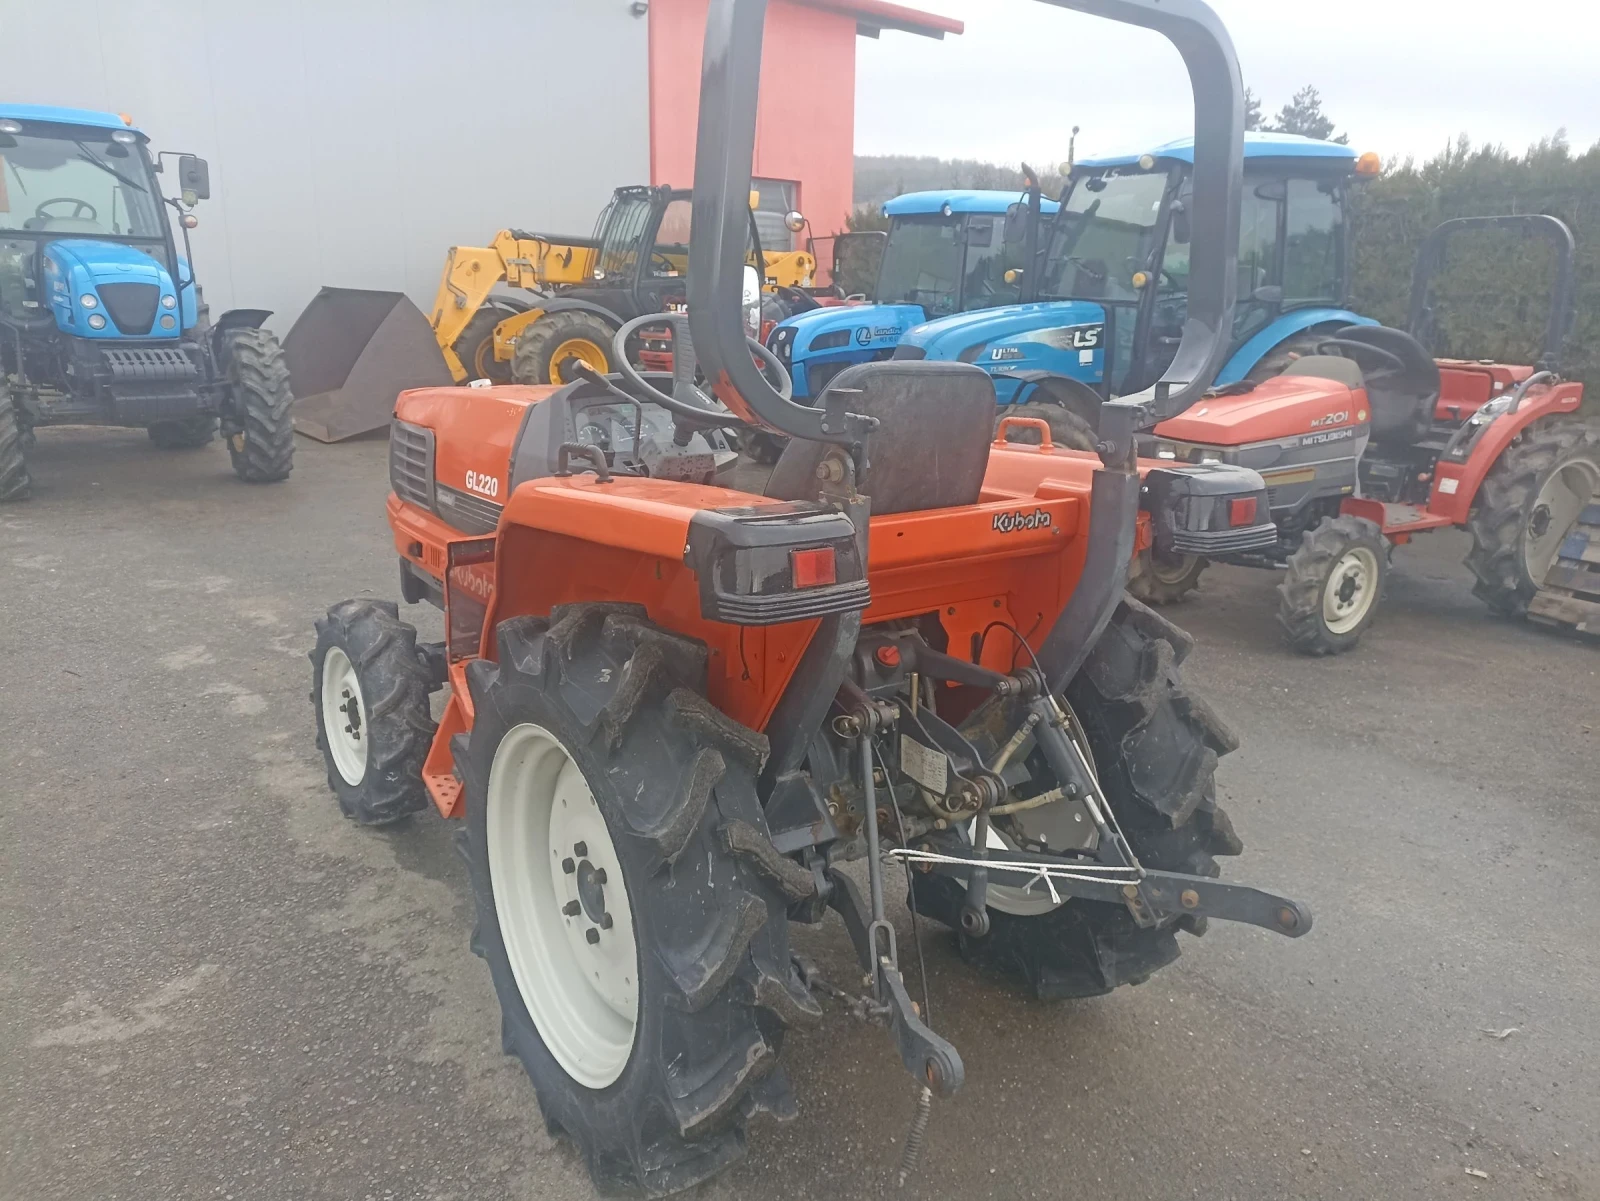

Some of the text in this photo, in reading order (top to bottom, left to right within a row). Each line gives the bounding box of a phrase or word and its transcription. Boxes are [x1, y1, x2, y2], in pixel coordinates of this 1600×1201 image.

[1073, 327, 1102, 347] LS
[1311, 411, 1349, 427] MT201
[1302, 430, 1352, 446] MITSUBISHI
[465, 470, 498, 497] GL220
[992, 508, 1052, 533] Kubota
